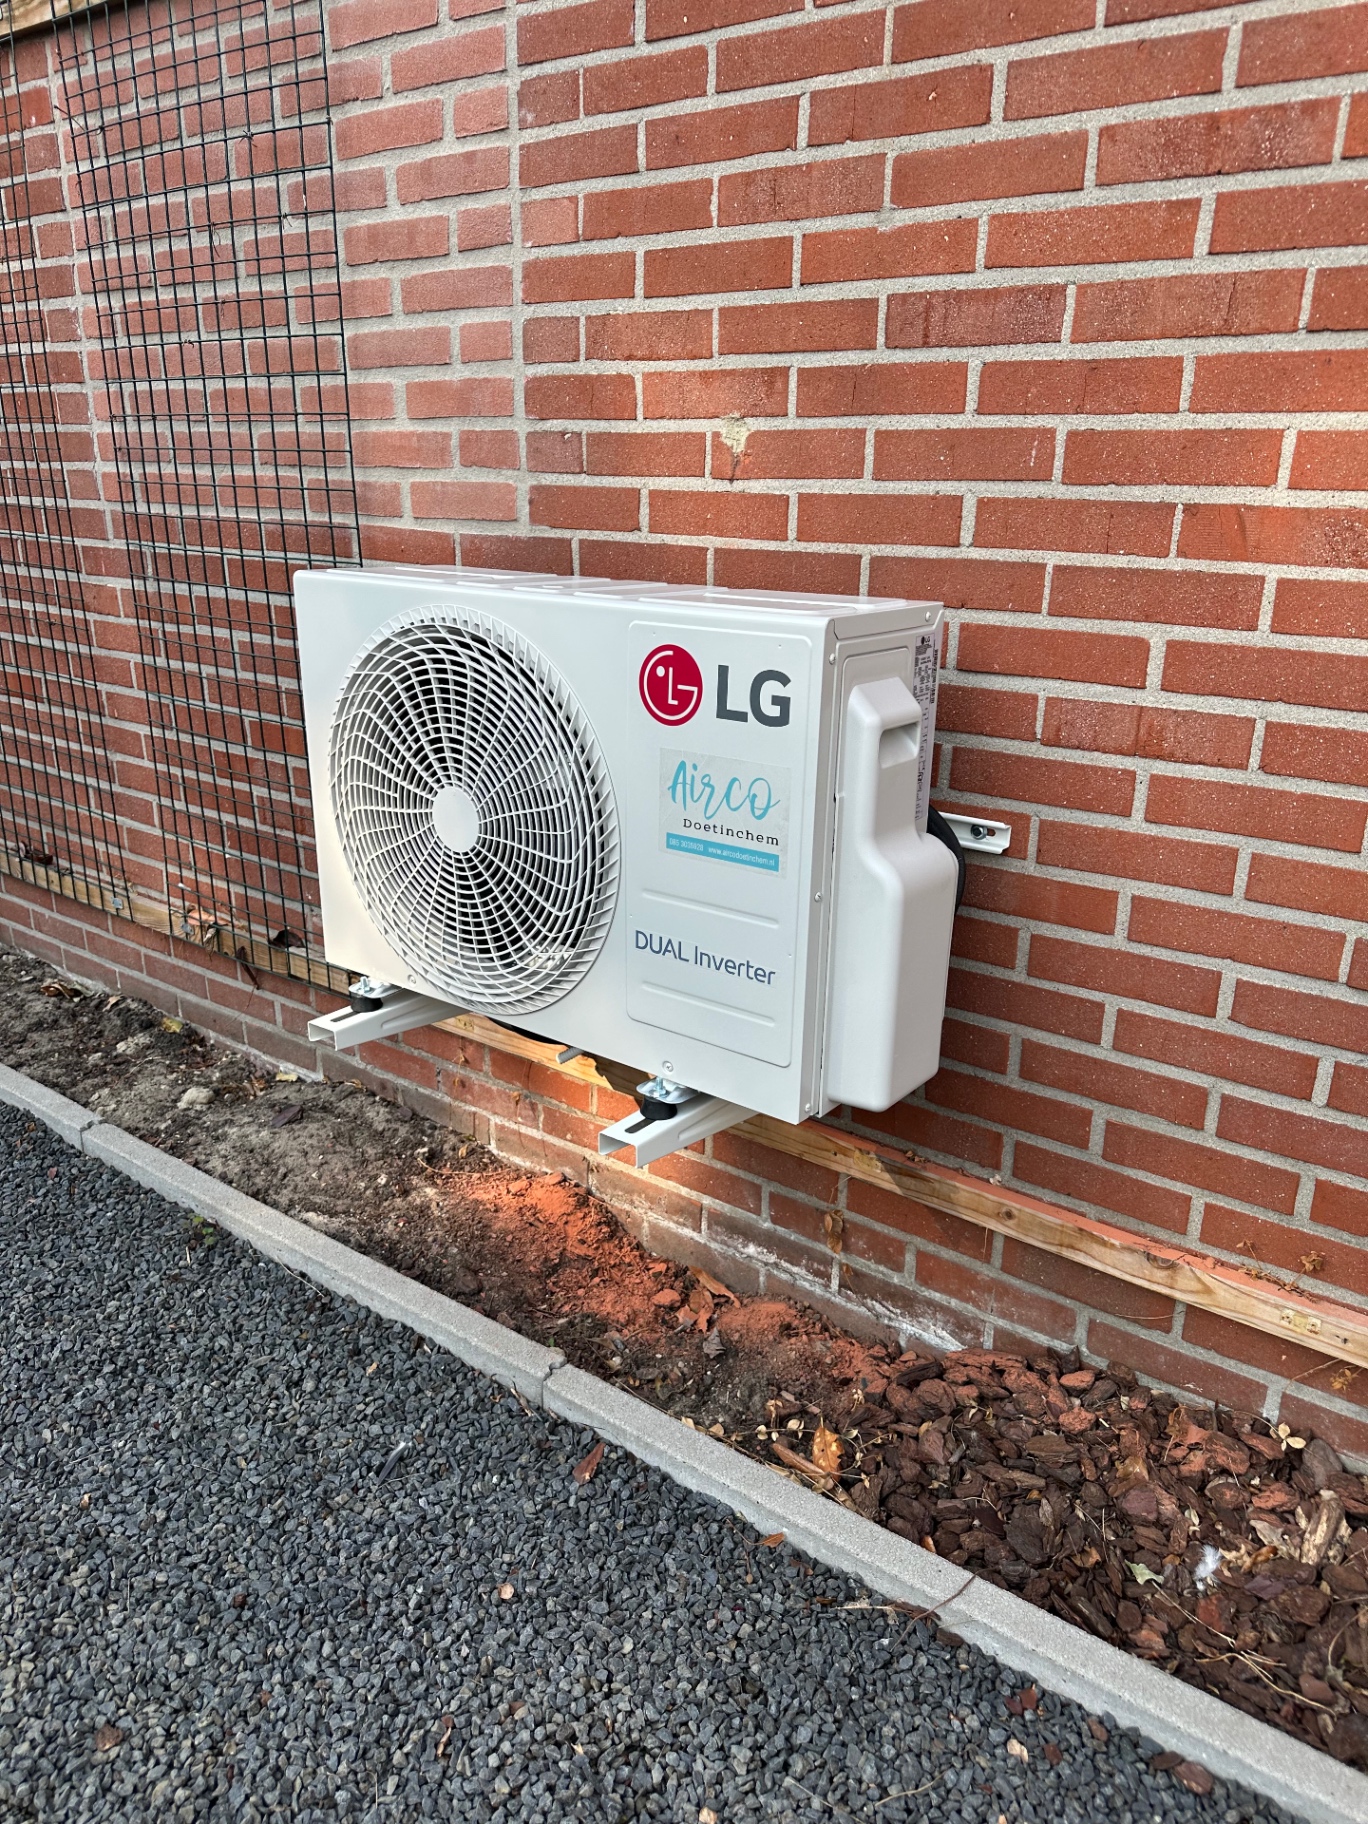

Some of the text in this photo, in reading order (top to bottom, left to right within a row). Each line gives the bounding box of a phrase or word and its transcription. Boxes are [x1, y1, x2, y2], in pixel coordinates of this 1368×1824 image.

[716, 664, 792, 728] LG
[683, 818, 779, 846] Doetinchem
[708, 846, 775, 867] www.aircodoetinchem.nl
[635, 929, 776, 985] DUAL Inverter
